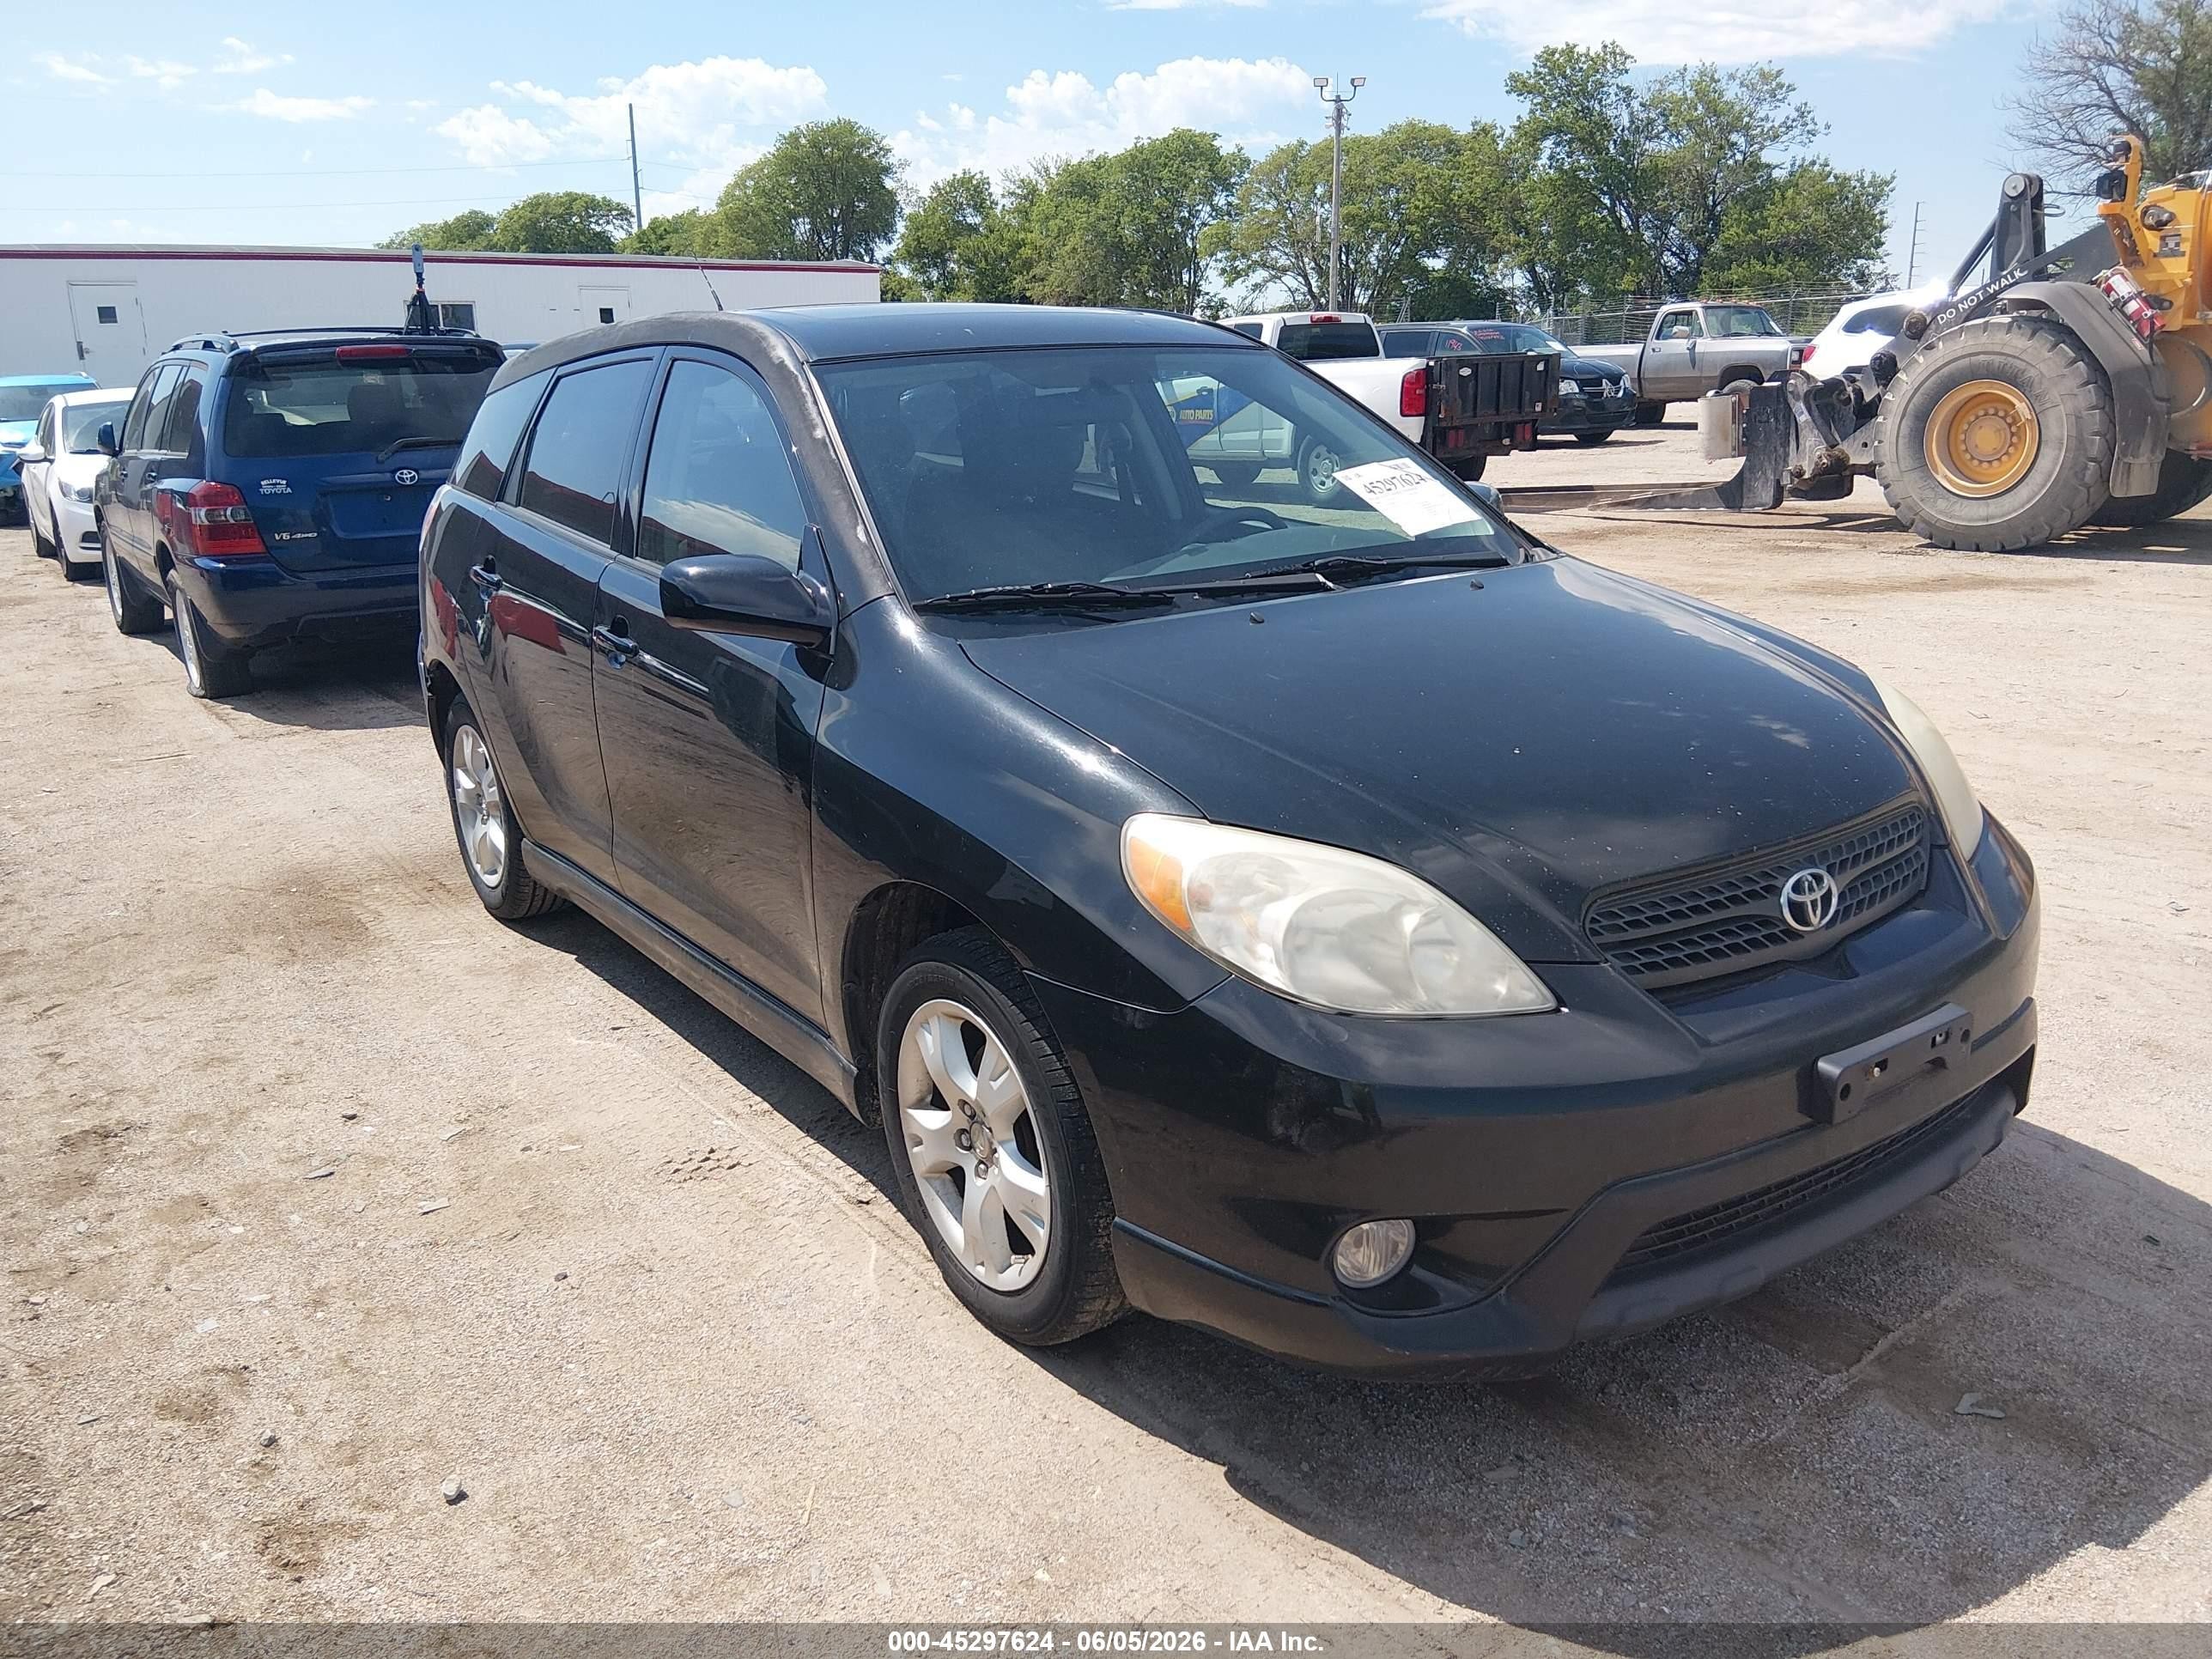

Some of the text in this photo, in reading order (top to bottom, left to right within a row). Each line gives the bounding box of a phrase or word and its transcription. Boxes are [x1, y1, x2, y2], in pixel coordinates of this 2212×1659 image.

[1937, 268, 2028, 325] DO NOT WALK
[1194, 408, 1214, 421] PARTS
[1363, 473, 1427, 495] 45297624
